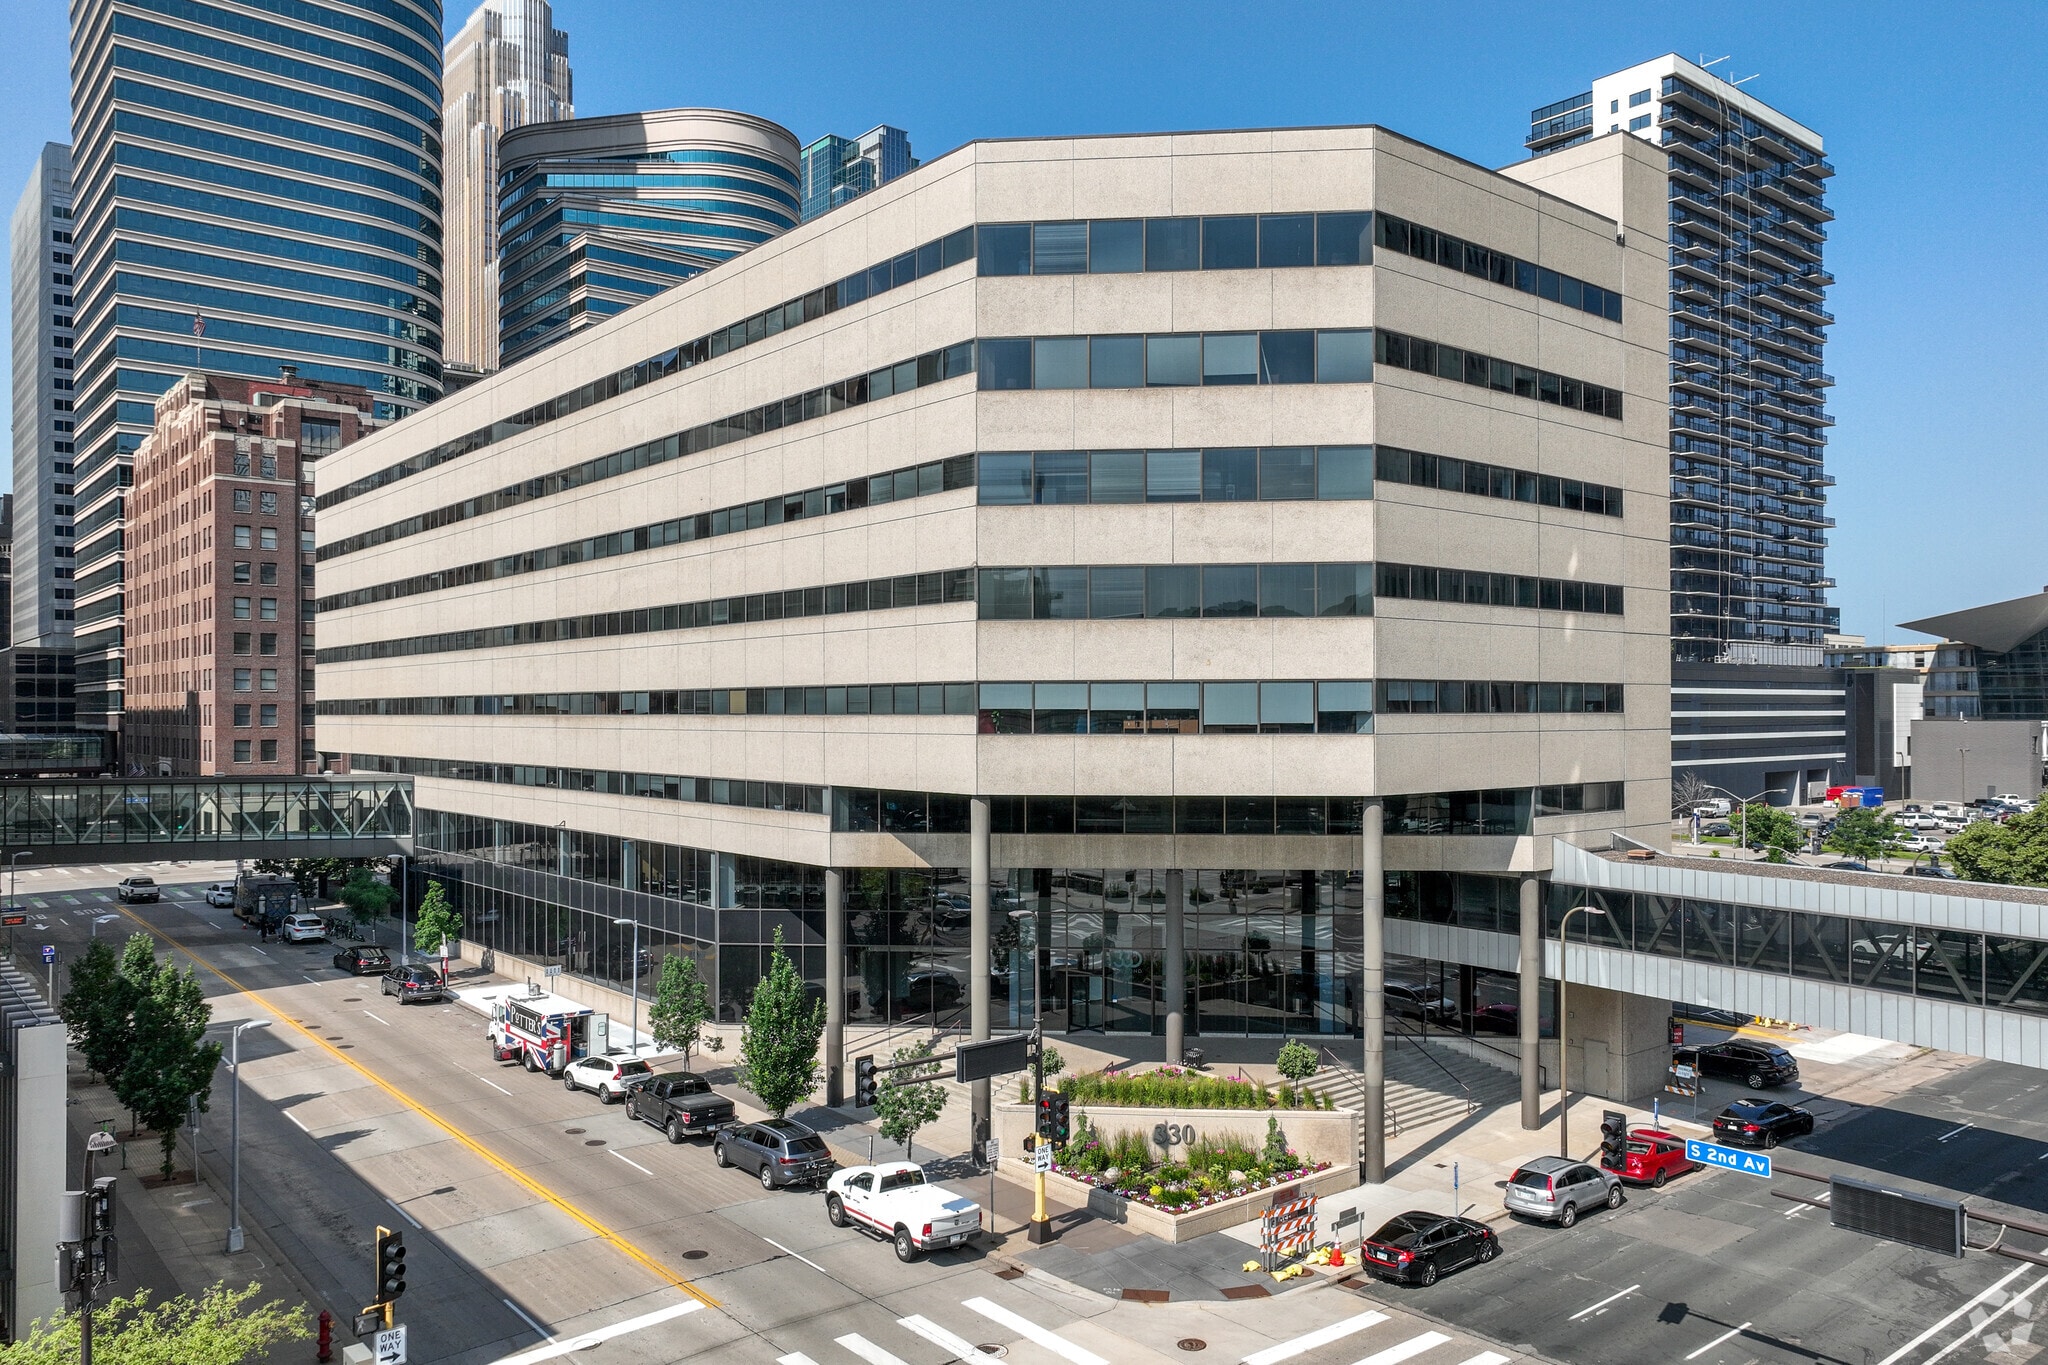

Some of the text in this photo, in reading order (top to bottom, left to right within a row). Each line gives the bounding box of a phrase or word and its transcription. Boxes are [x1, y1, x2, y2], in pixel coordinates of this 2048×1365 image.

[1153, 1123, 1196, 1146] 330
[1037, 1147, 1049, 1155] ONE
[1037, 1153, 1049, 1162] WAY
[1691, 1144, 1765, 1172] S 2nd Av
[380, 1330, 401, 1343] ONE
[380, 1339, 401, 1352] WAY
